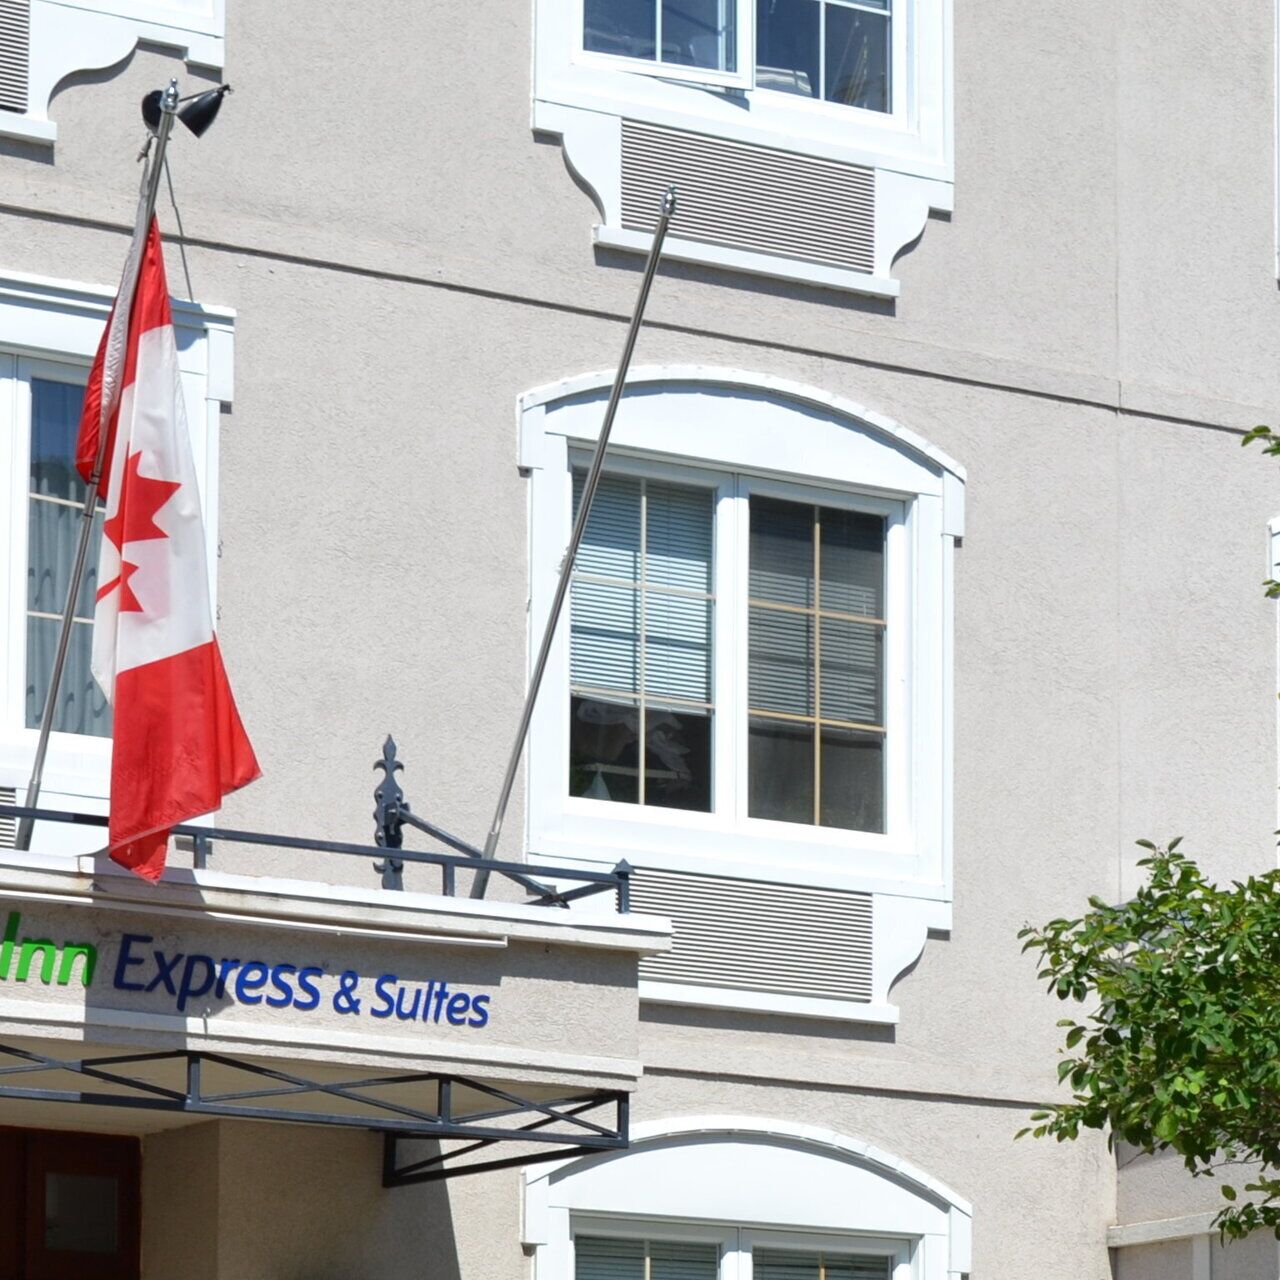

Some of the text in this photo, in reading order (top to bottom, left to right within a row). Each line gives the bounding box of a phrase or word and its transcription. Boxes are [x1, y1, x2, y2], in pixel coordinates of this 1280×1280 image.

[113, 933, 322, 1012] Express
[333, 969, 361, 1015] &
[370, 974, 491, 1028] Suites
